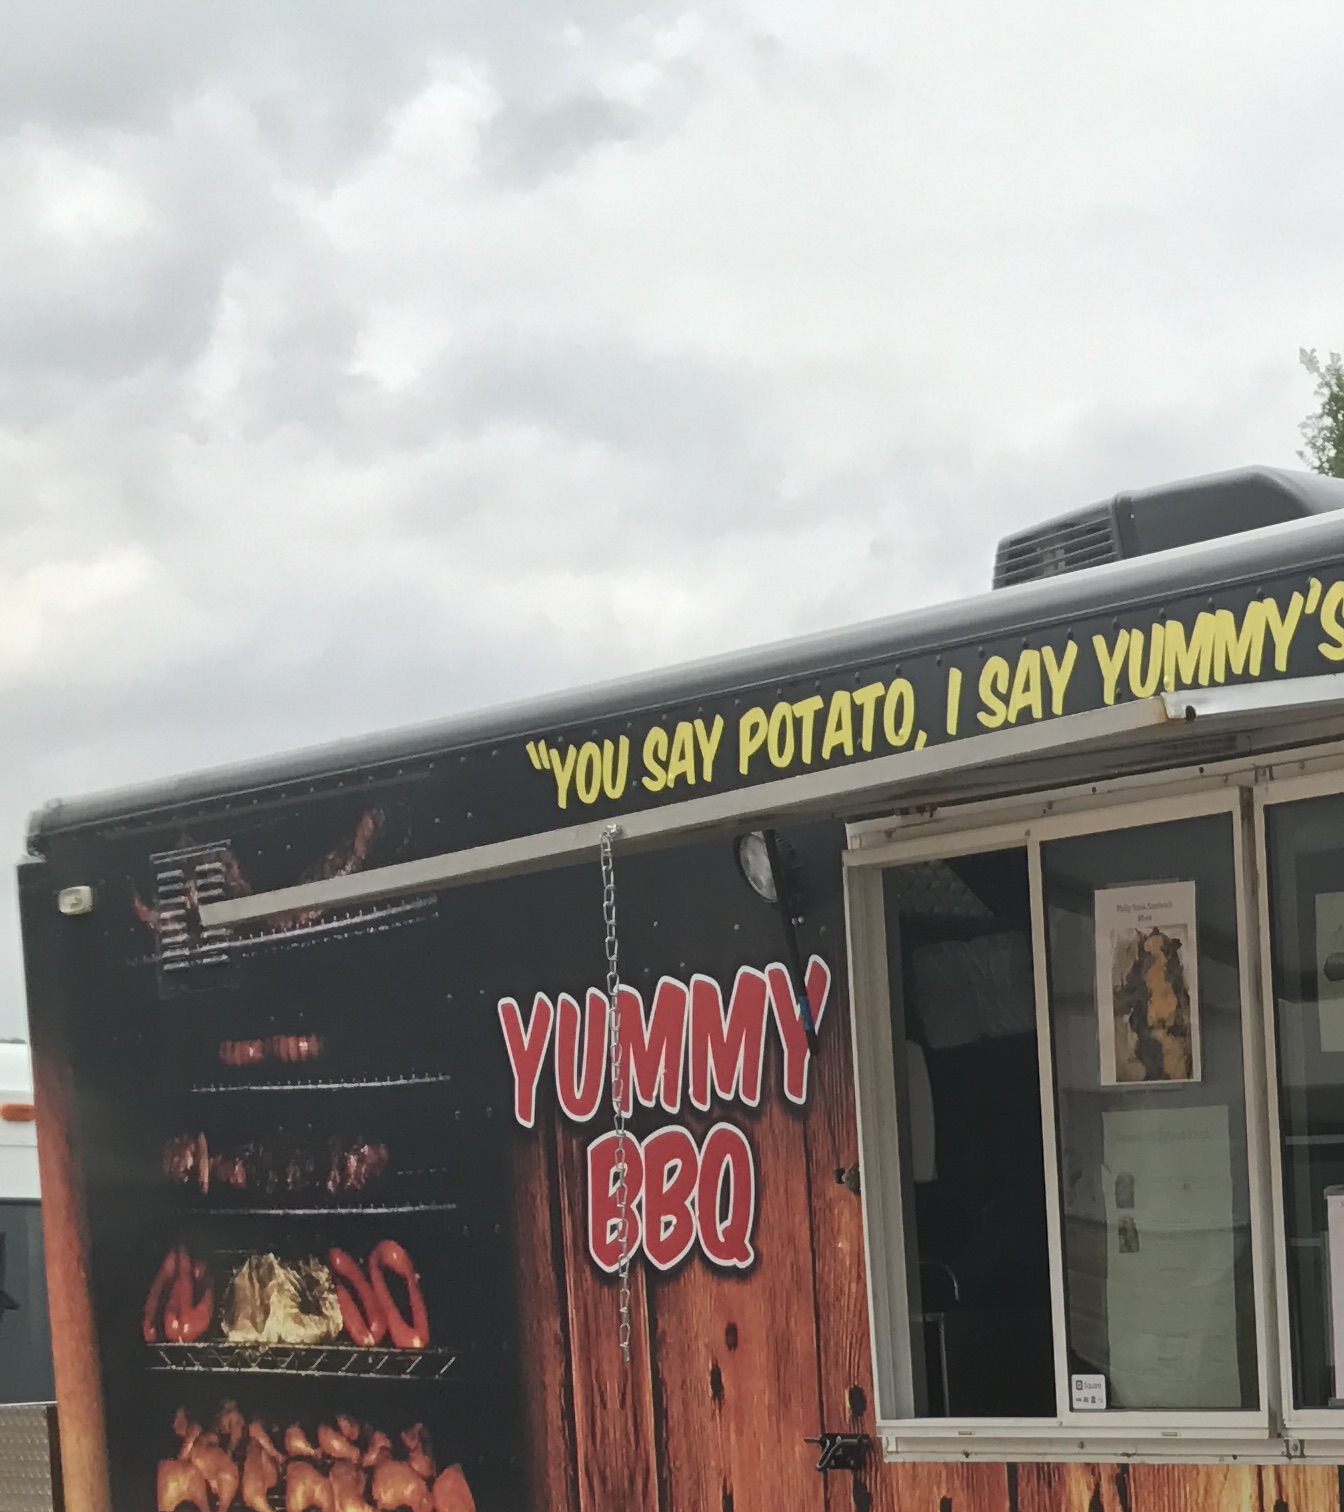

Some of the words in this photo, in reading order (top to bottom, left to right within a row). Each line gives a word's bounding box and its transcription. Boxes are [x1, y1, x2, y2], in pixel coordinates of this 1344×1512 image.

[642, 717, 723, 791] SAY
[739, 677, 930, 775] POTATO,
[946, 667, 963, 735] I
[976, 640, 1079, 729] SAY
[498, 953, 831, 1128] YUMMY
[586, 1122, 755, 1274] BBQ
